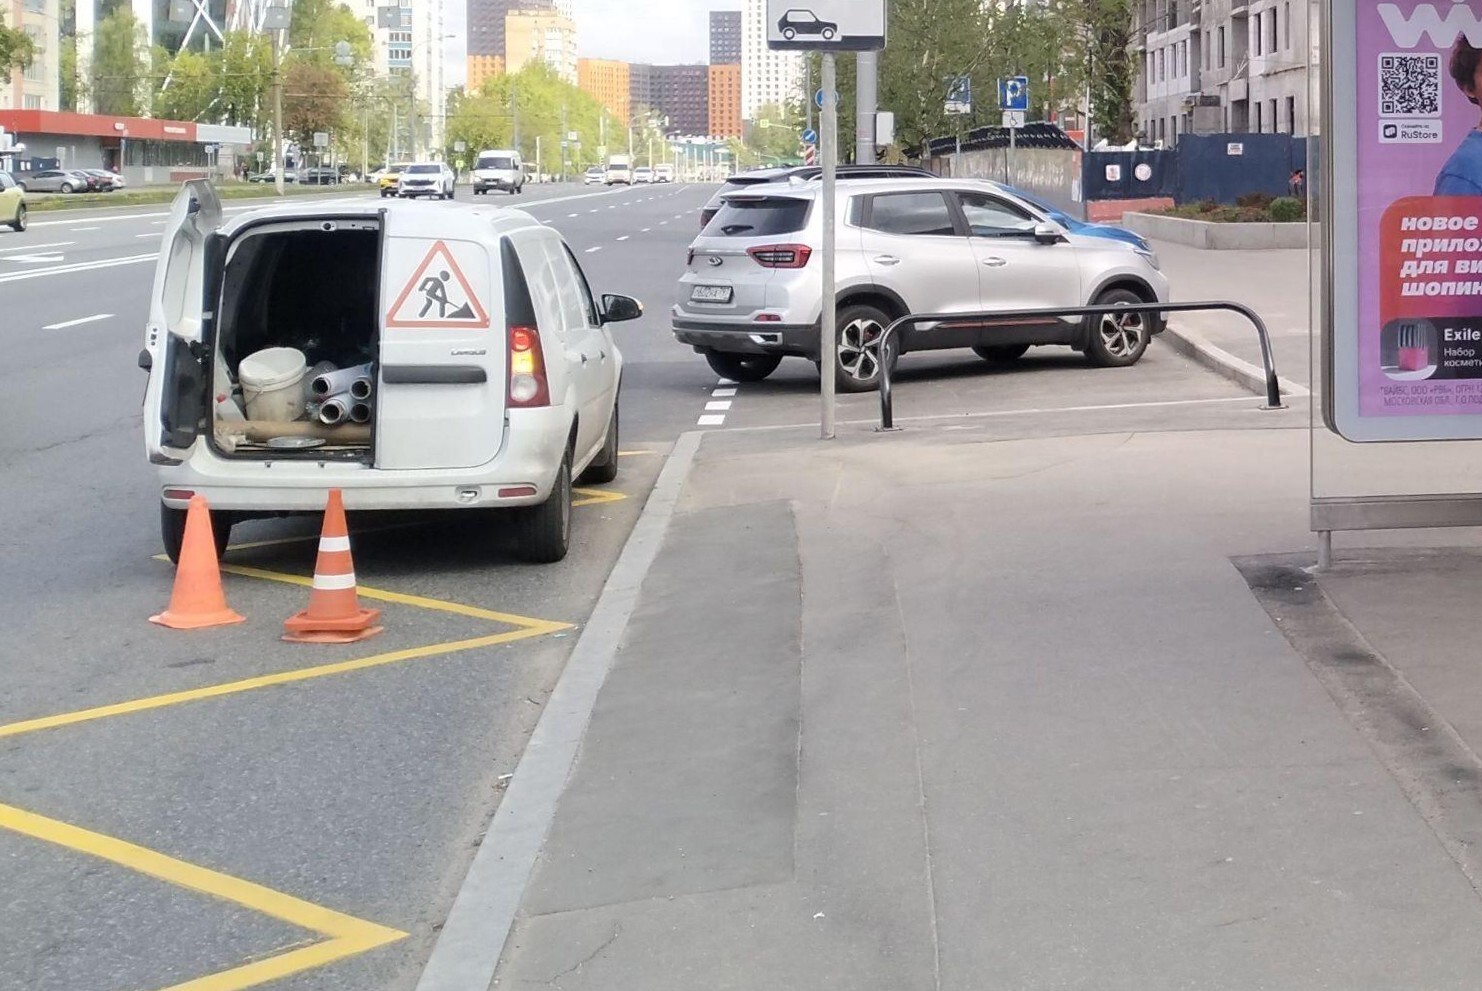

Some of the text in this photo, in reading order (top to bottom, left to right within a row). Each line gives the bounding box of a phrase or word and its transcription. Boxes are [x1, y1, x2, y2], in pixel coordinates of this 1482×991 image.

[1401, 130, 1438, 139] RuStore
[1401, 216, 1479, 231] новое
[1400, 260, 1448, 278] для
[1444, 328, 1481, 341] Exile
[1443, 347, 1475, 357] Набор
